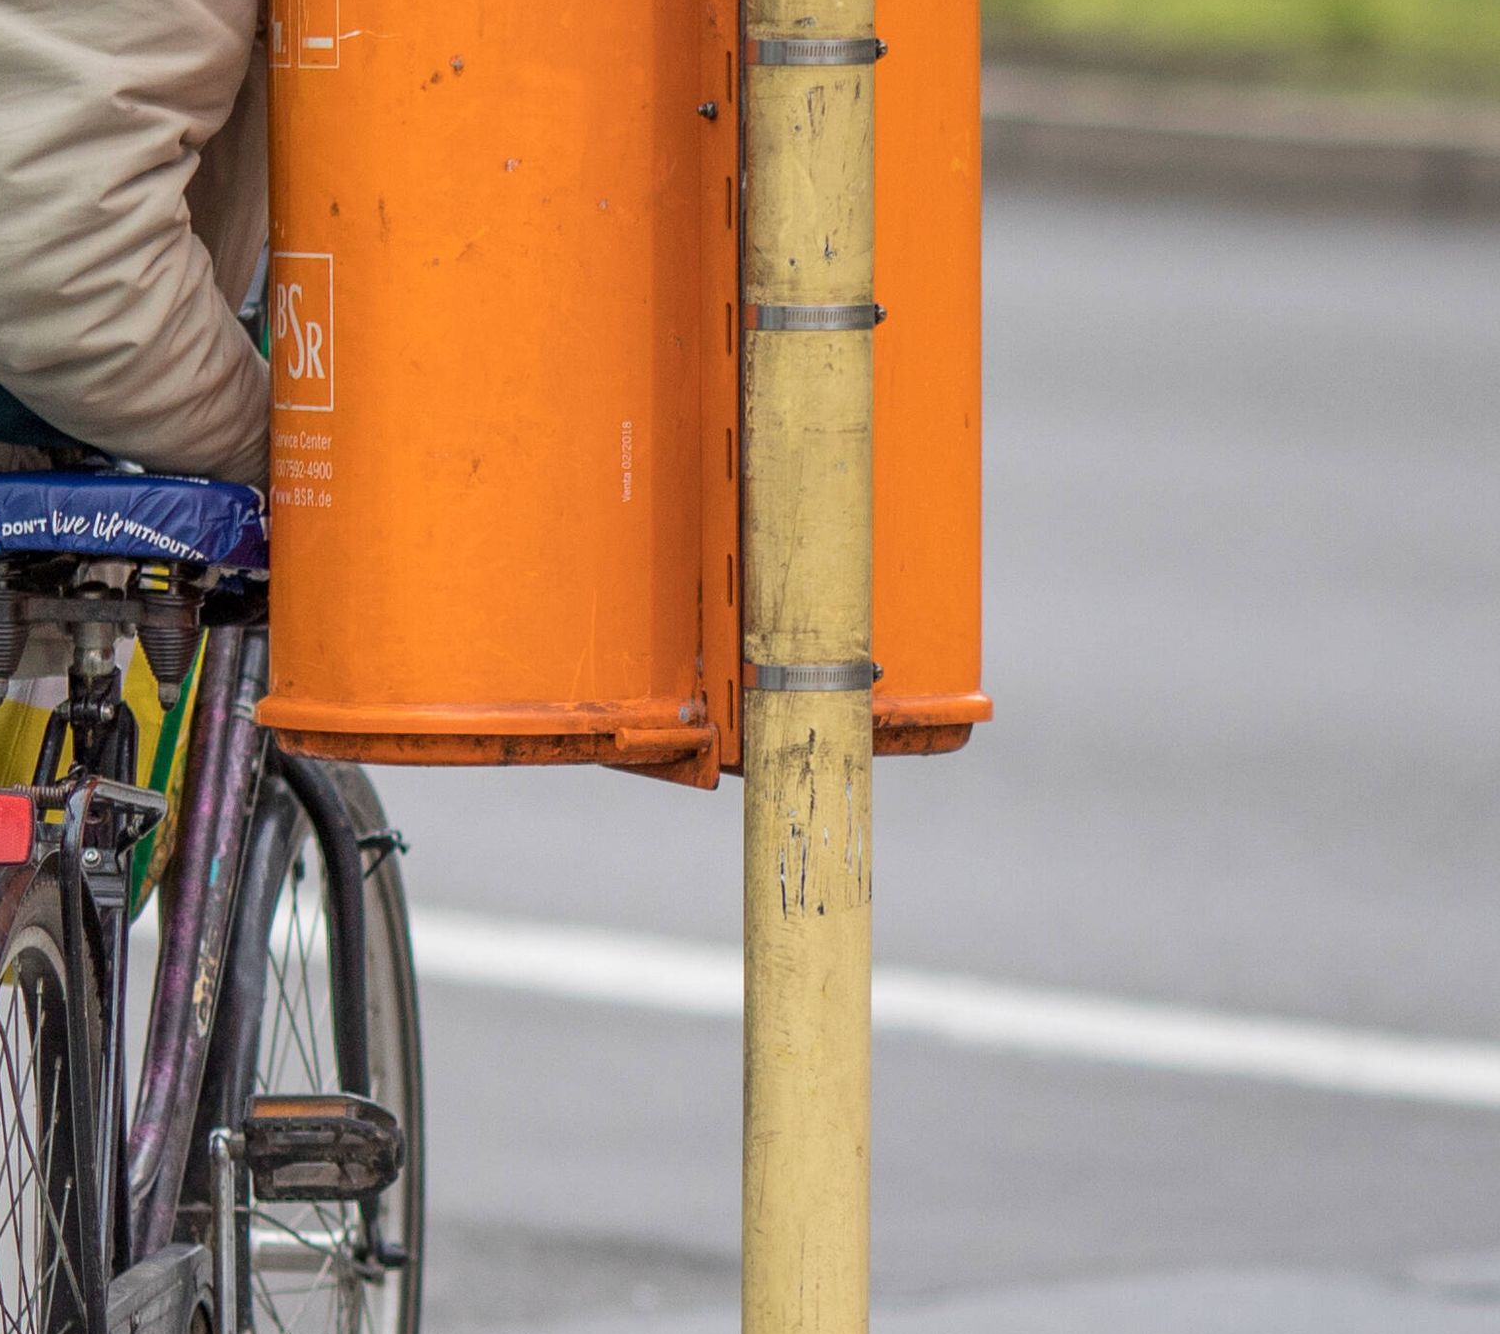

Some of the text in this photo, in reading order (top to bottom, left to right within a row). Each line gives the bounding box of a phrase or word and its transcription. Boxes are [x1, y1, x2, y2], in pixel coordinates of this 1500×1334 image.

[277, 283, 325, 380] BSR
[299, 430, 332, 451] Center
[621, 421, 632, 469] 02/2018
[2, 518, 47, 536] DON'T
[52, 510, 90, 536] live
[93, 512, 124, 542] life
[123, 519, 190, 558] WITHOUT
